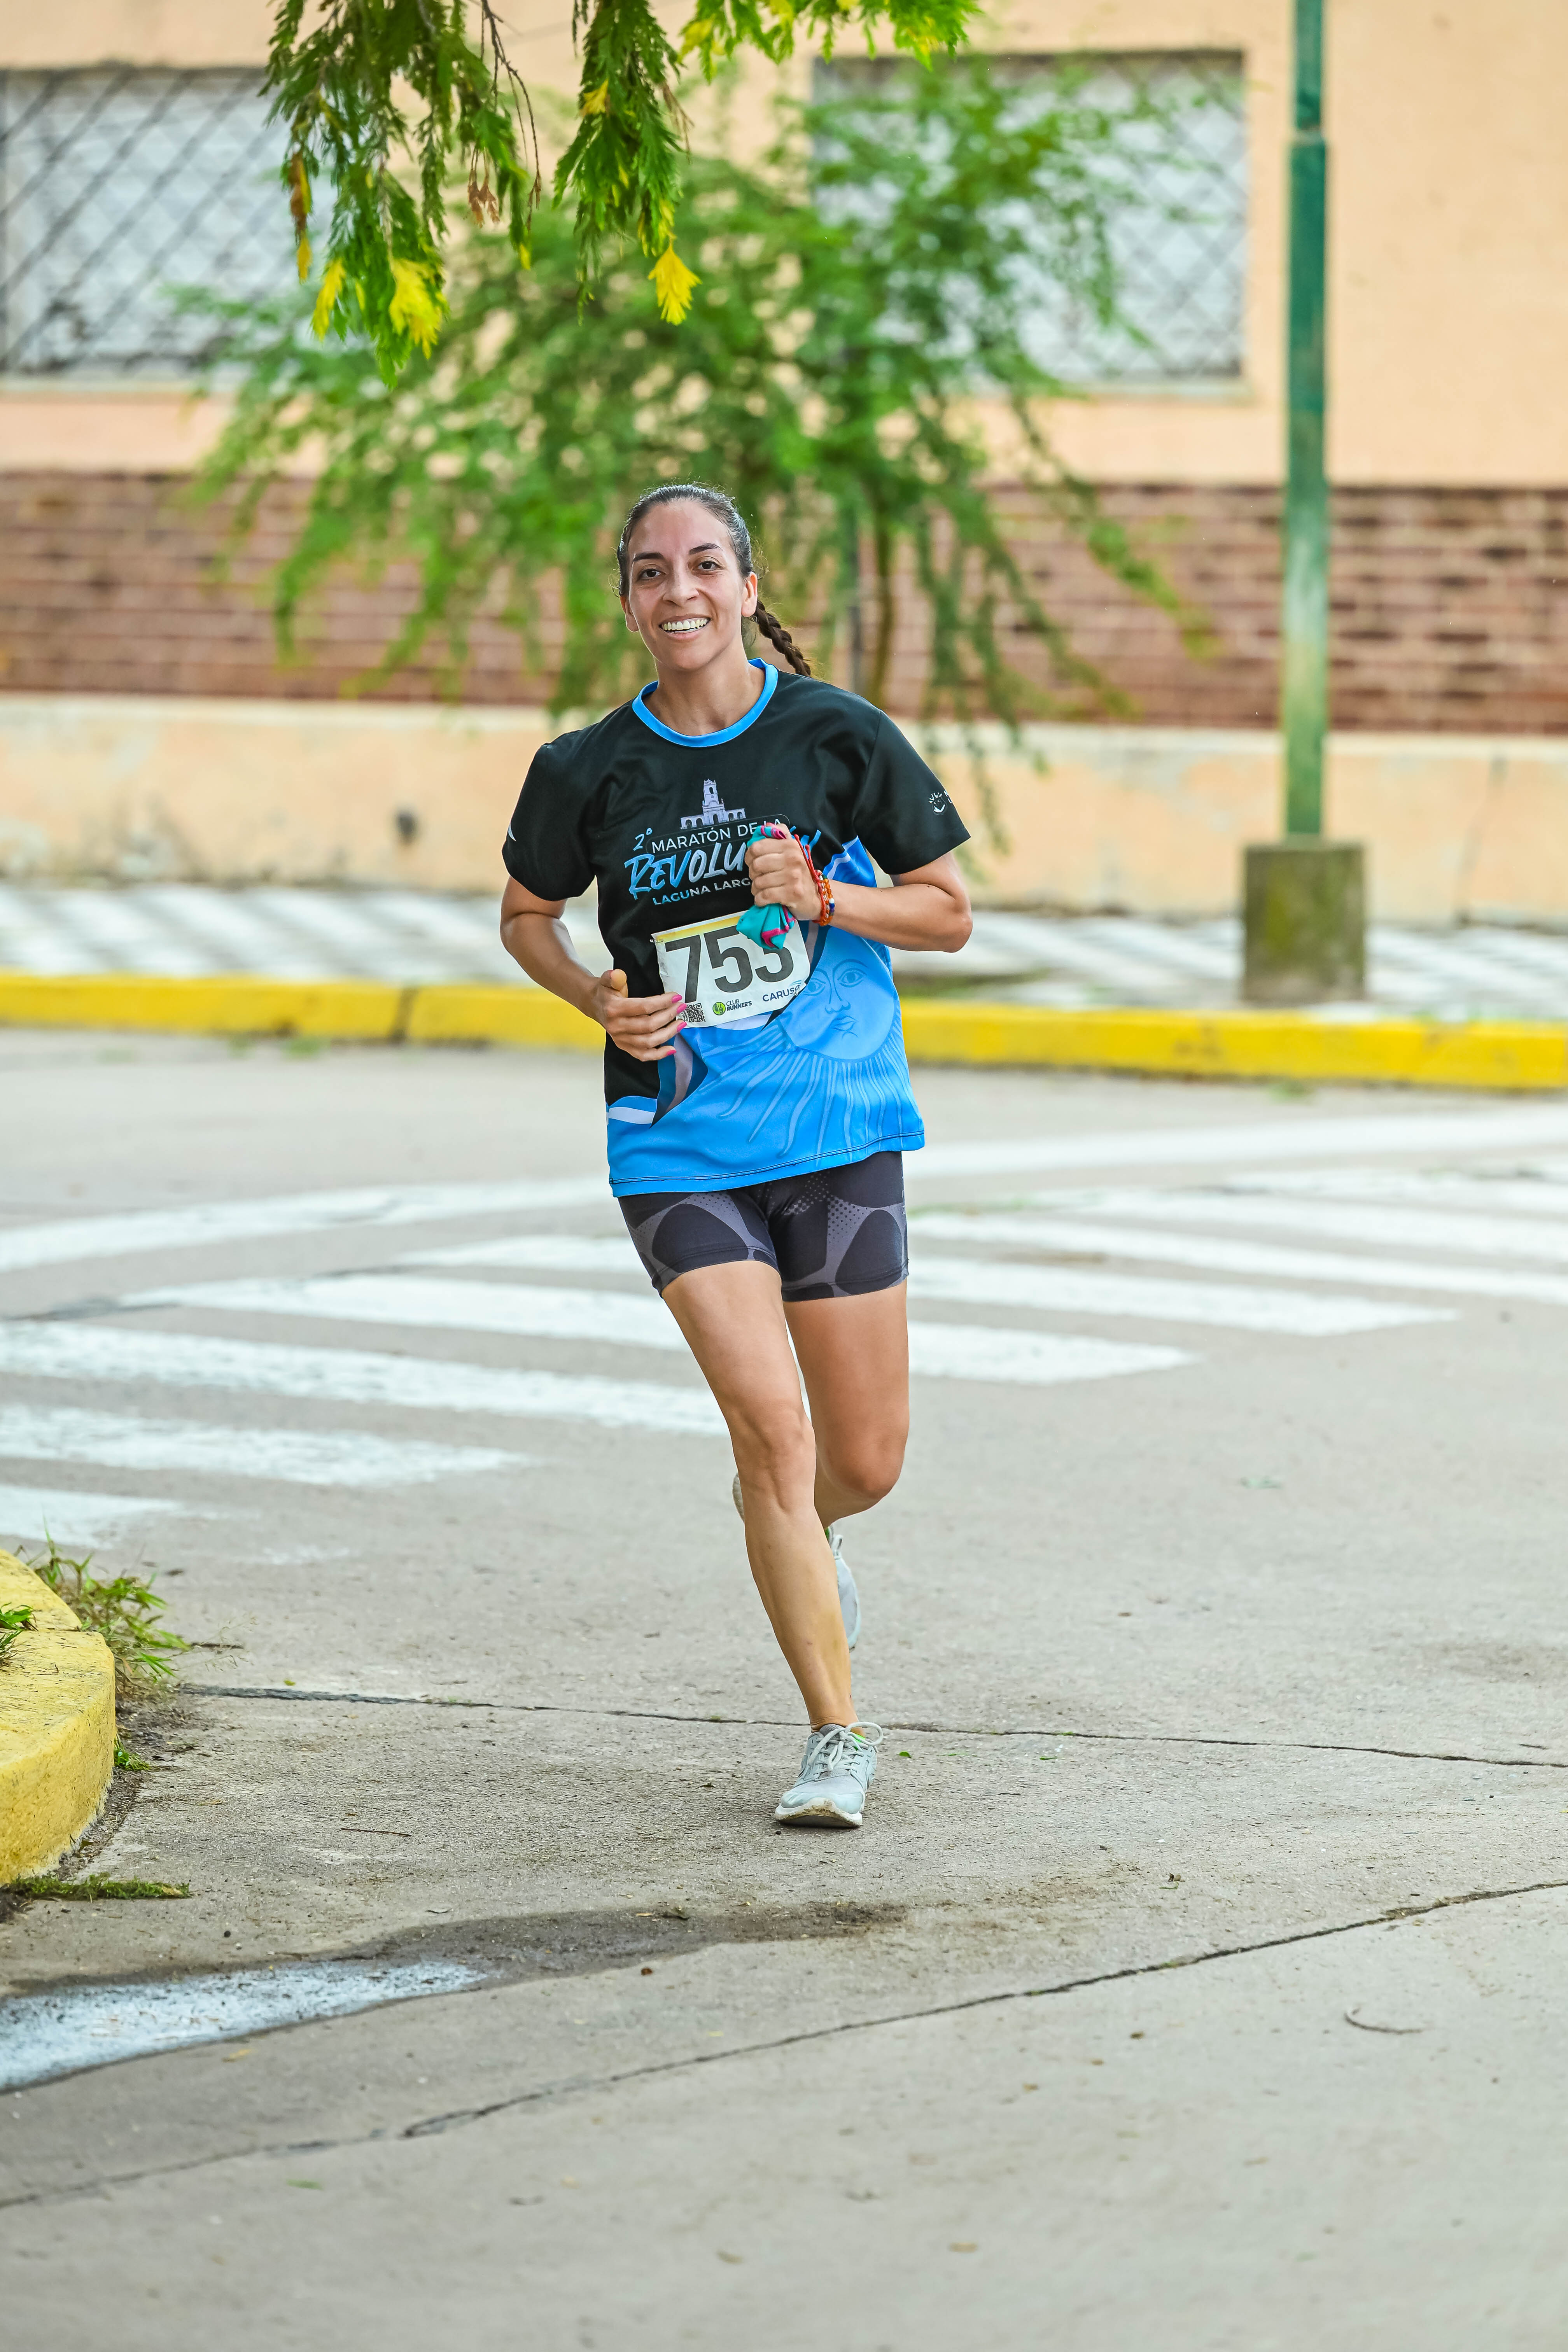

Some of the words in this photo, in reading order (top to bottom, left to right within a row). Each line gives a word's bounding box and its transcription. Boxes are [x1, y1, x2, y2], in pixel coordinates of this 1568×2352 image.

[651, 827, 731, 853] MARATÓN
[737, 822, 757, 836] DE
[624, 842, 747, 900] REVOLU
[653, 885, 710, 905] LAGUNA
[714, 878, 751, 891] LARG
[727, 1001, 752, 1011] RUNNER'S
[762, 985, 800, 1002] CARUSO
